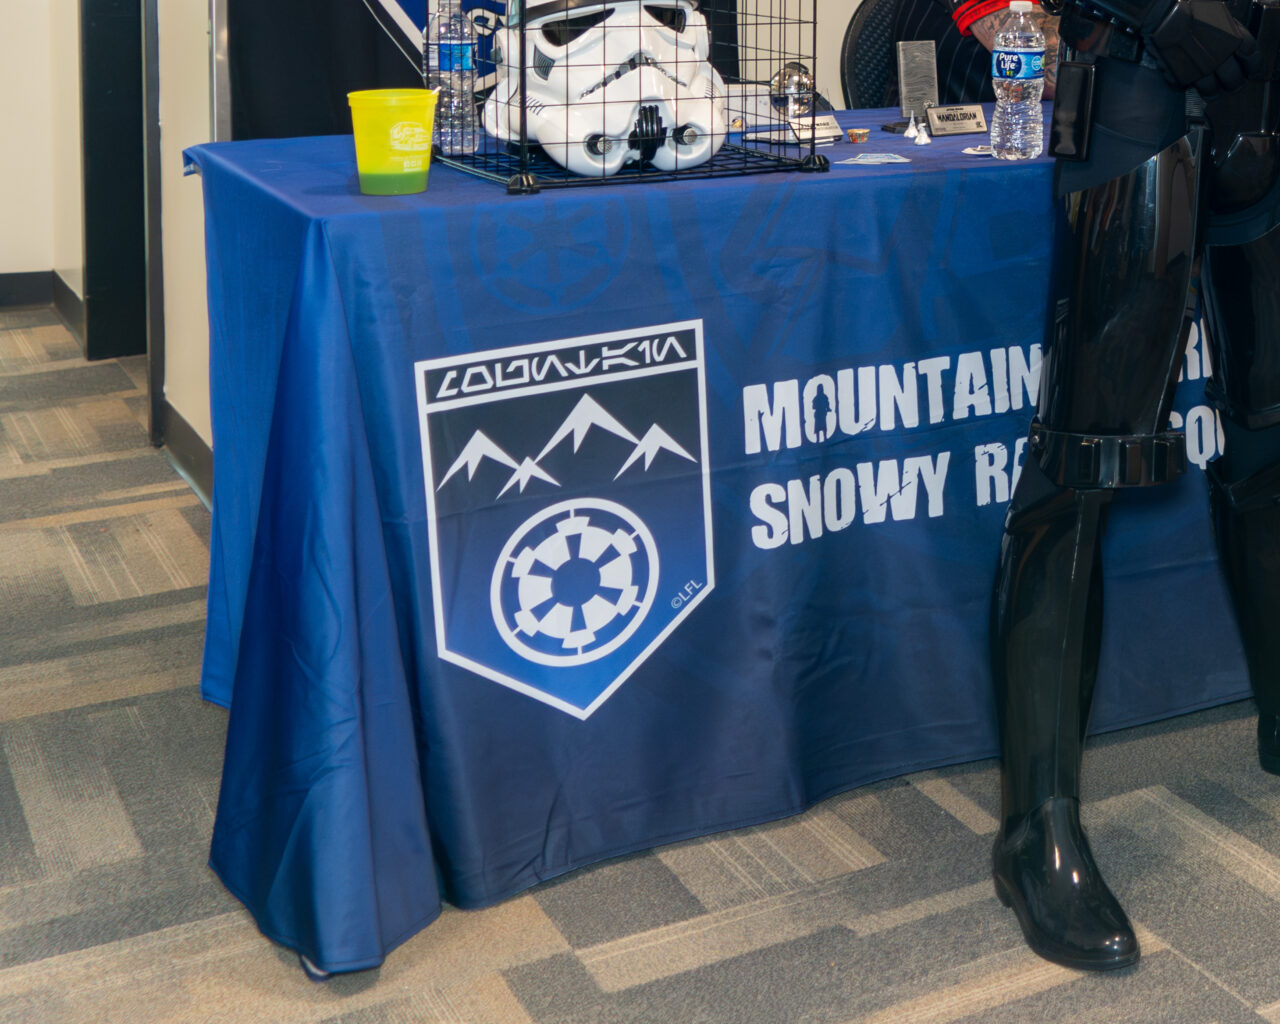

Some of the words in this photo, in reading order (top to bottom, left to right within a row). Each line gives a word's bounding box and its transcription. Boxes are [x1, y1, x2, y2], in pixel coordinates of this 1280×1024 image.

[999, 53, 1019, 61] Pure
[1001, 61, 1016, 70] Life
[743, 343, 1042, 455] MOUNTAIN
[750, 451, 951, 550] SNOWY
